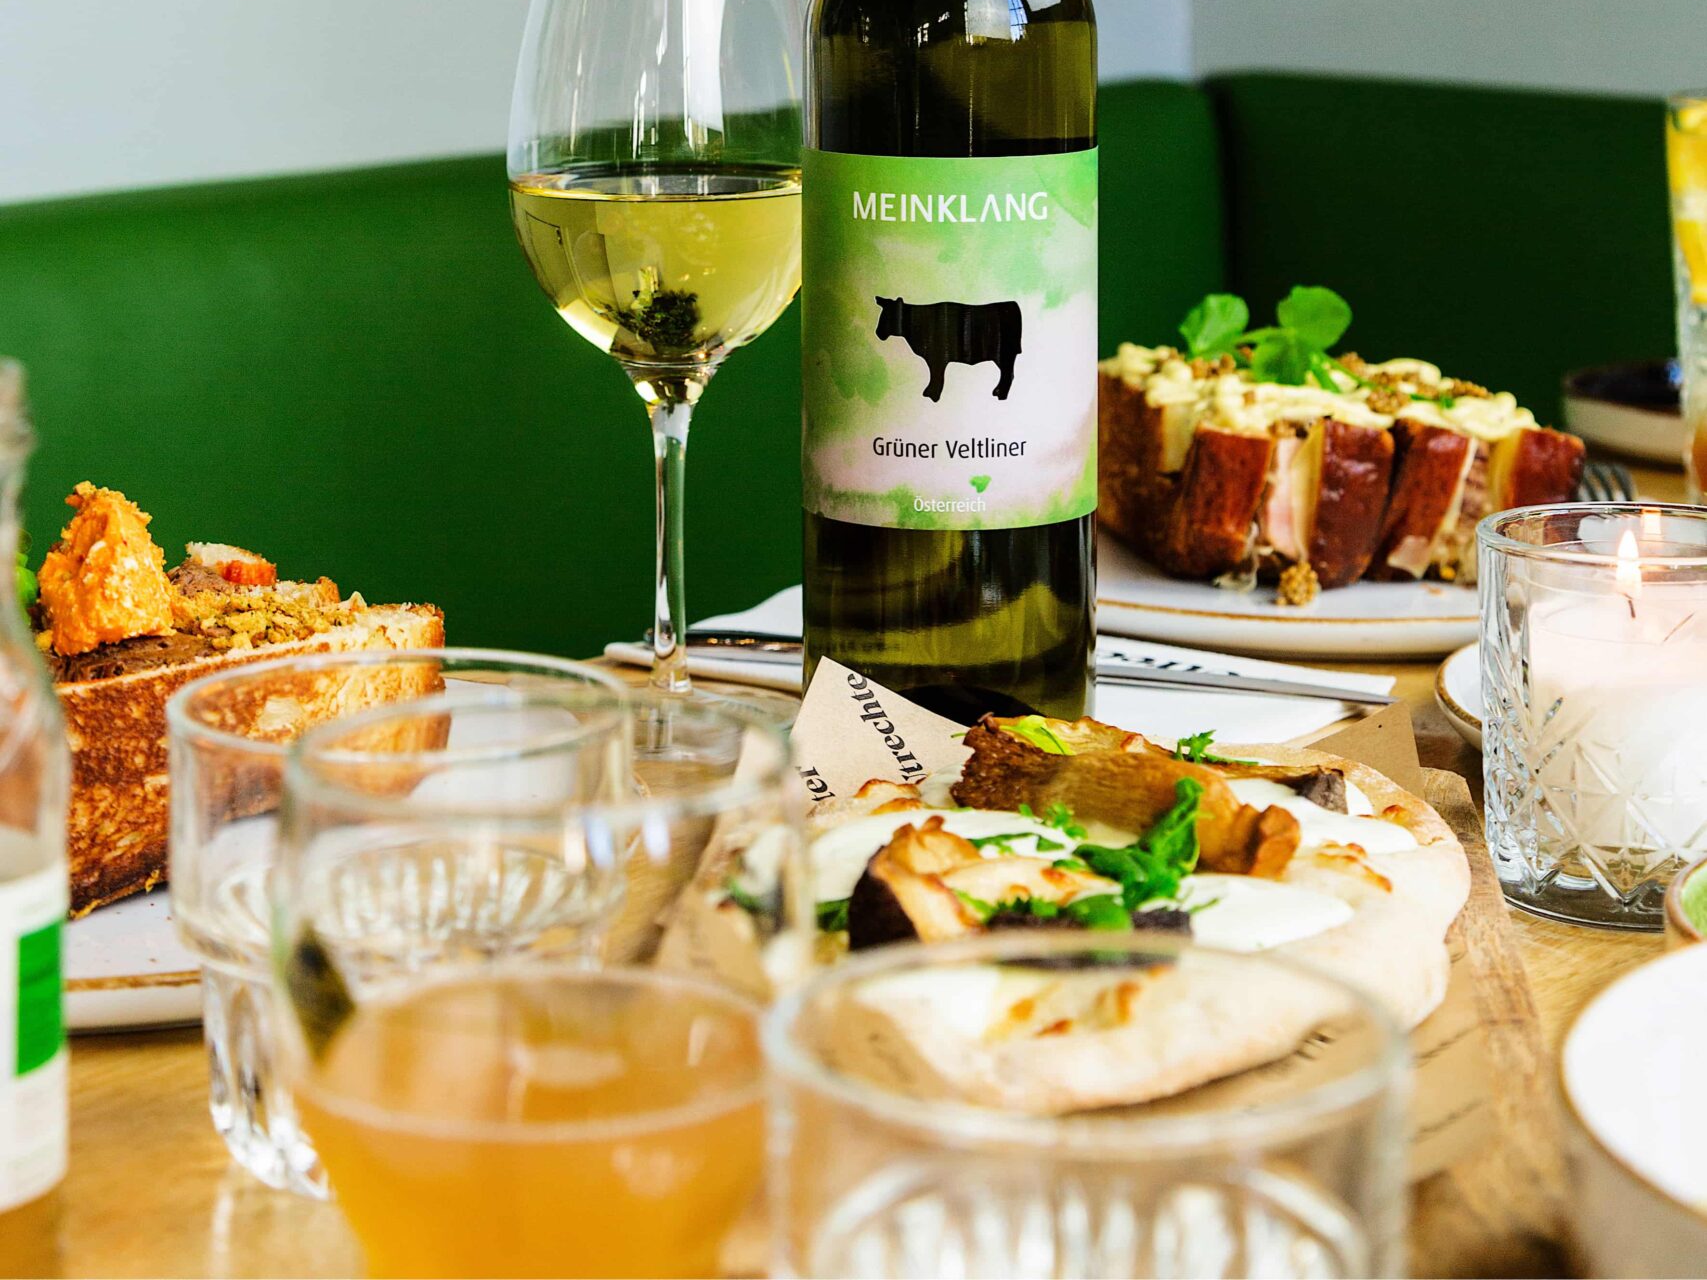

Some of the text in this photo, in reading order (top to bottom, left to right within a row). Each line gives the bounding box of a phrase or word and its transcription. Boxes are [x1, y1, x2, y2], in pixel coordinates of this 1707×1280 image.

[852, 191, 1048, 223] MEINKLANG
[872, 436, 1027, 459] Grüner Veltliner
[913, 494, 987, 513] Österreich
